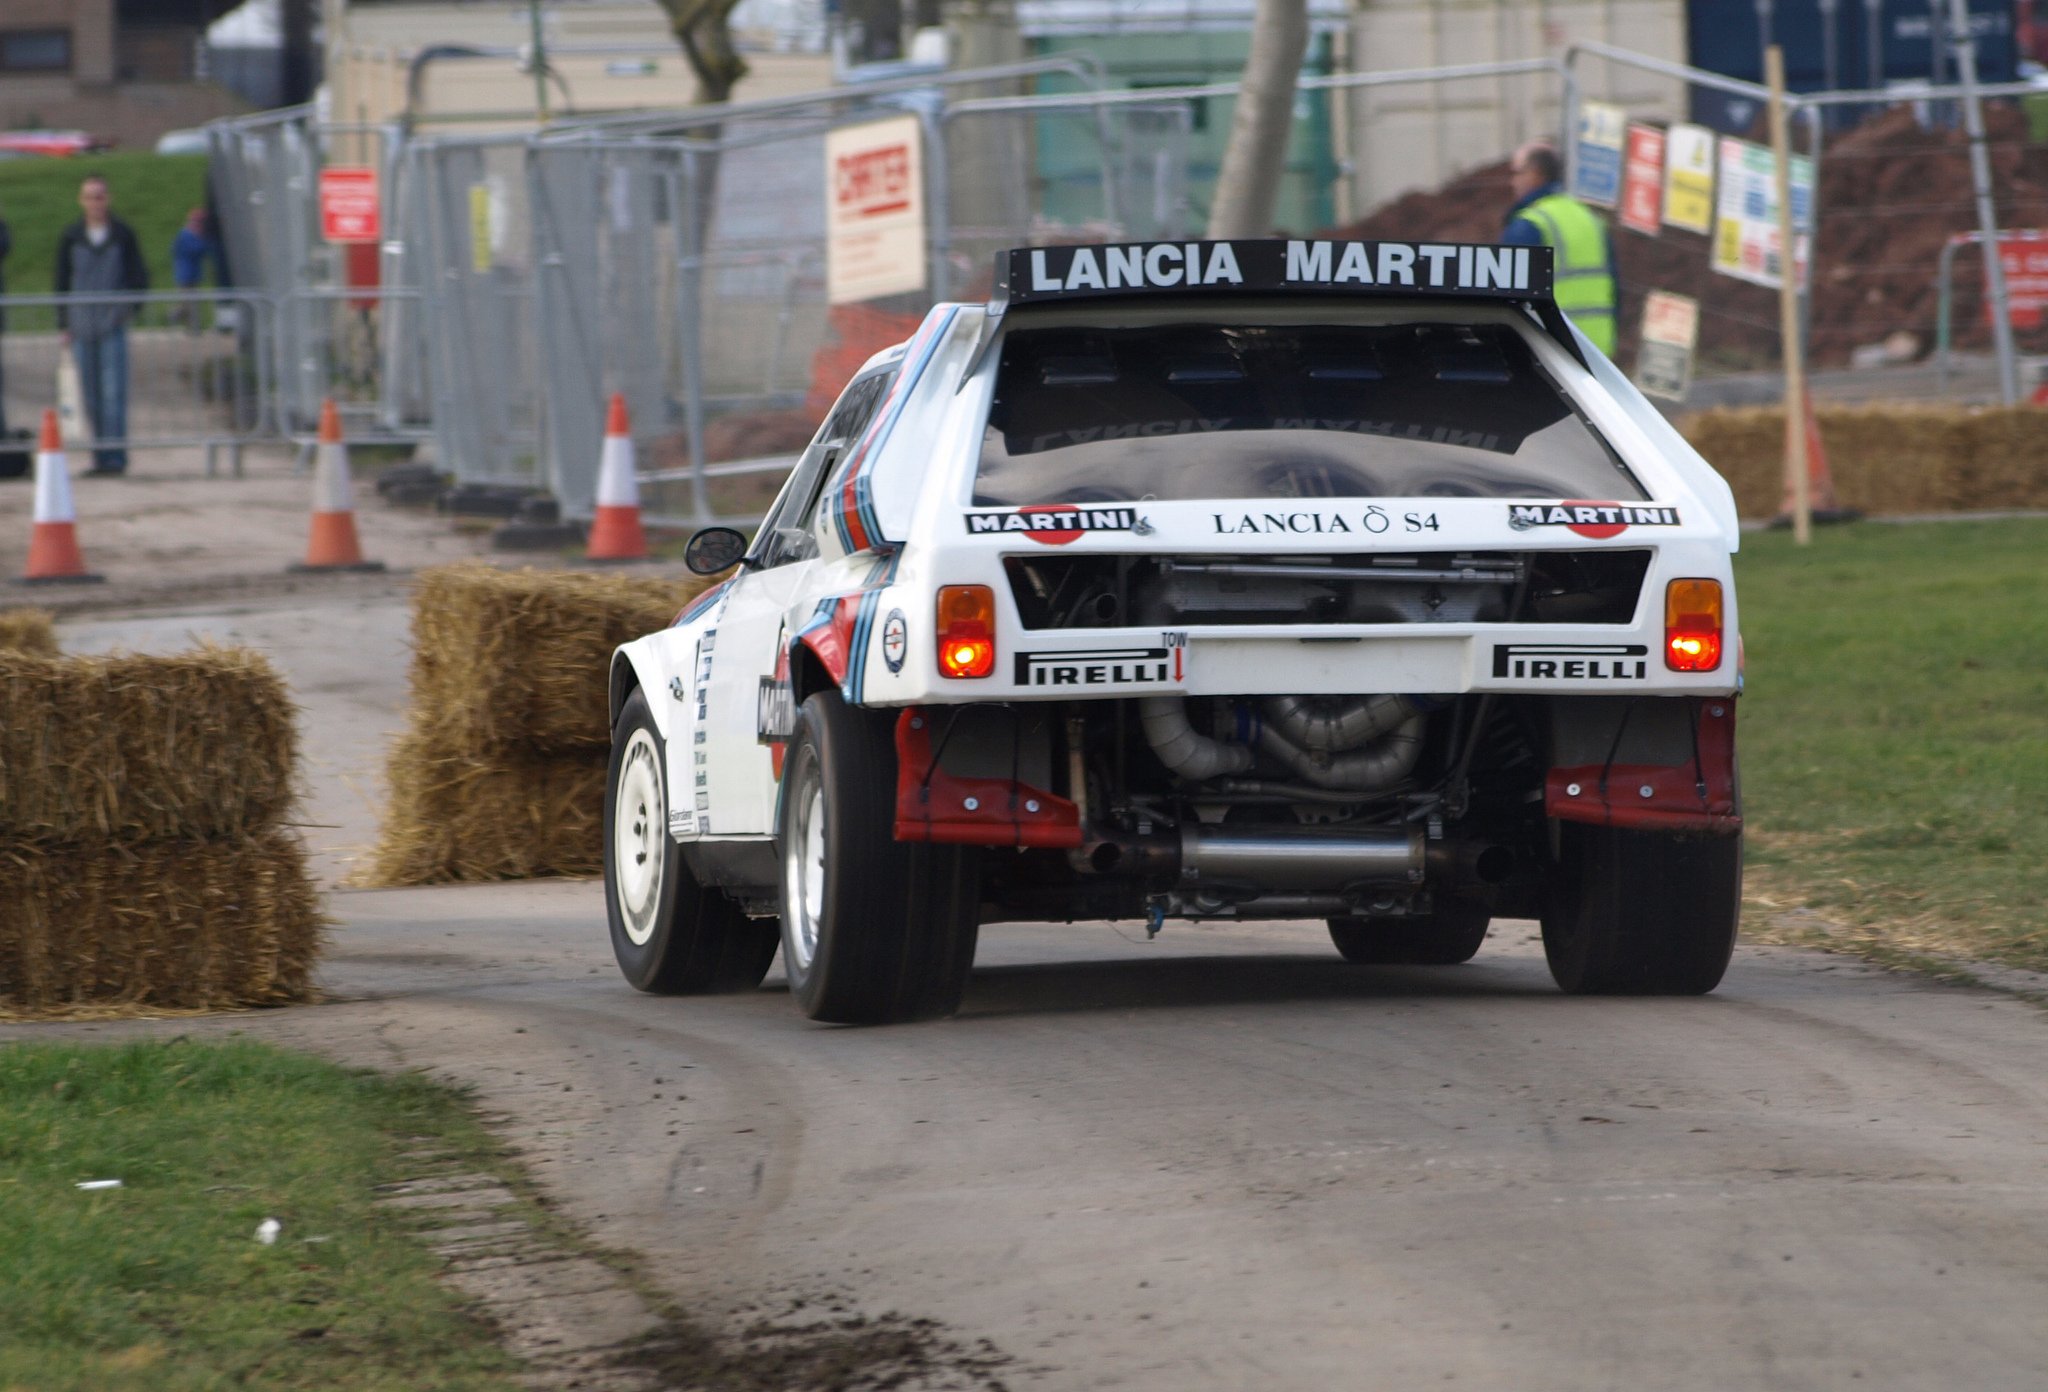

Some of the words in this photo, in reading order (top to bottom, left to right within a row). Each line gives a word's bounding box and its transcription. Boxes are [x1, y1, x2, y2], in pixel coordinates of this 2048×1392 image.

[1031, 242, 1244, 291] LANCIA
[1286, 240, 1530, 290] MARTINI
[970, 510, 1132, 532] MARTINI
[1212, 513, 1352, 534] LANCIA
[1404, 512, 1440, 533] S4
[1513, 506, 1674, 525] MARTINI
[1162, 631, 1188, 647] TOW
[1014, 648, 1169, 686] PIRELLI
[1492, 644, 1648, 680] PIRELLI
